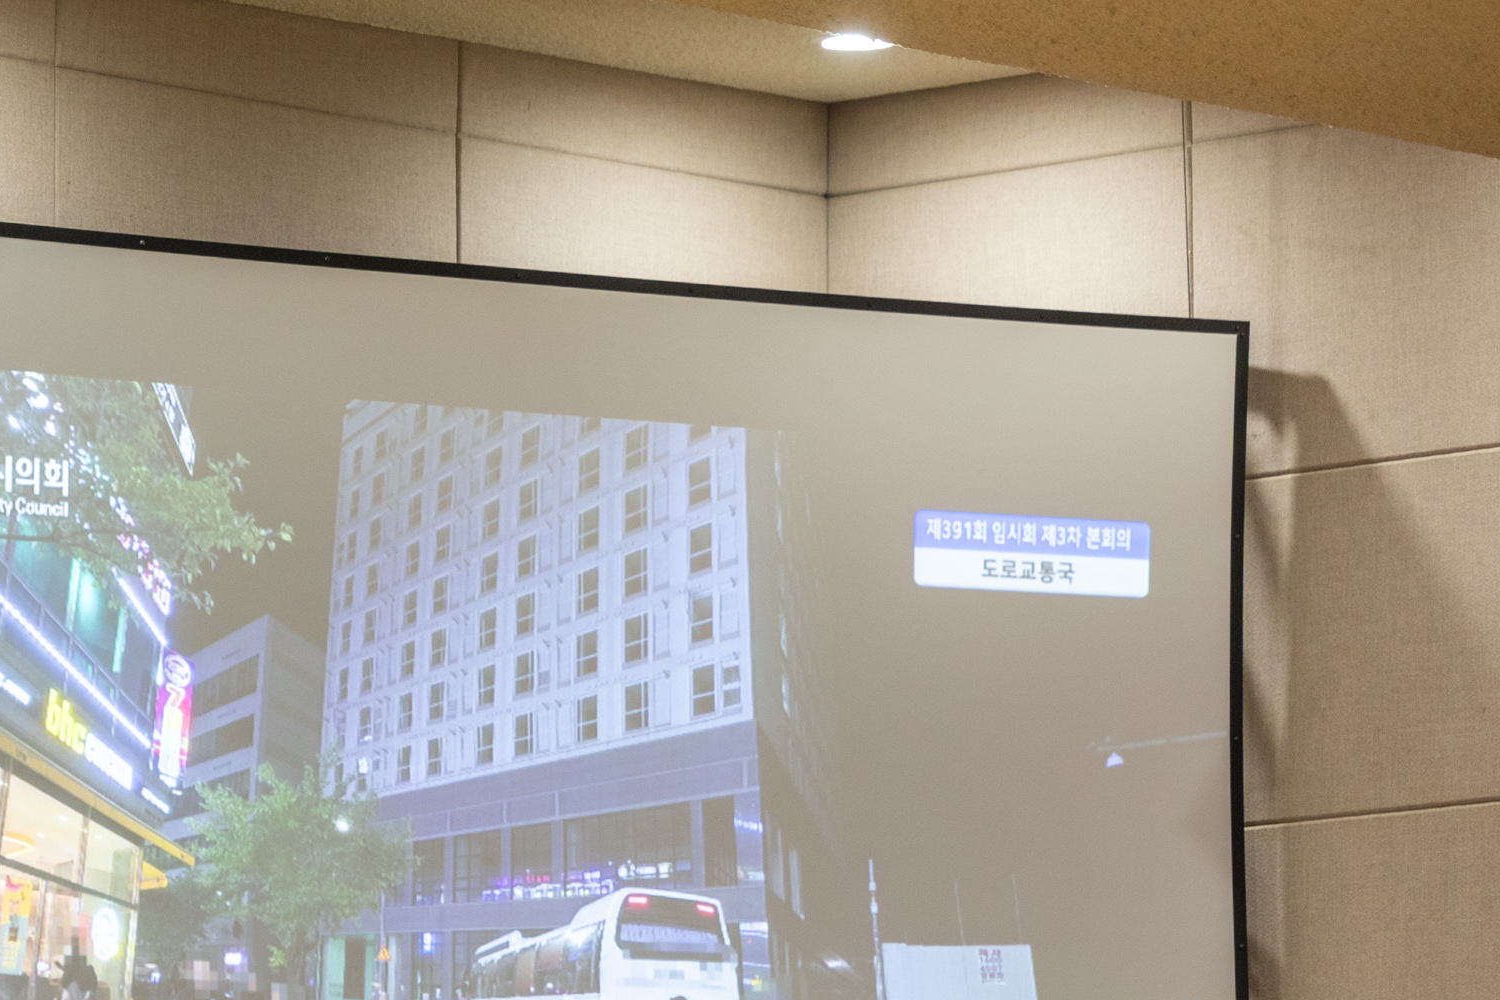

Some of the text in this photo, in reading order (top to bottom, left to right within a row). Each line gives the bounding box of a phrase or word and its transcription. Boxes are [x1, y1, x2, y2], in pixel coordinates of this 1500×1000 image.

[14, 497, 69, 518] Council
[926, 518, 1131, 551] 제391회 임시회 제3차 본회의
[981, 559, 1075, 585] 도로교통국
[45, 687, 88, 755] bhc
